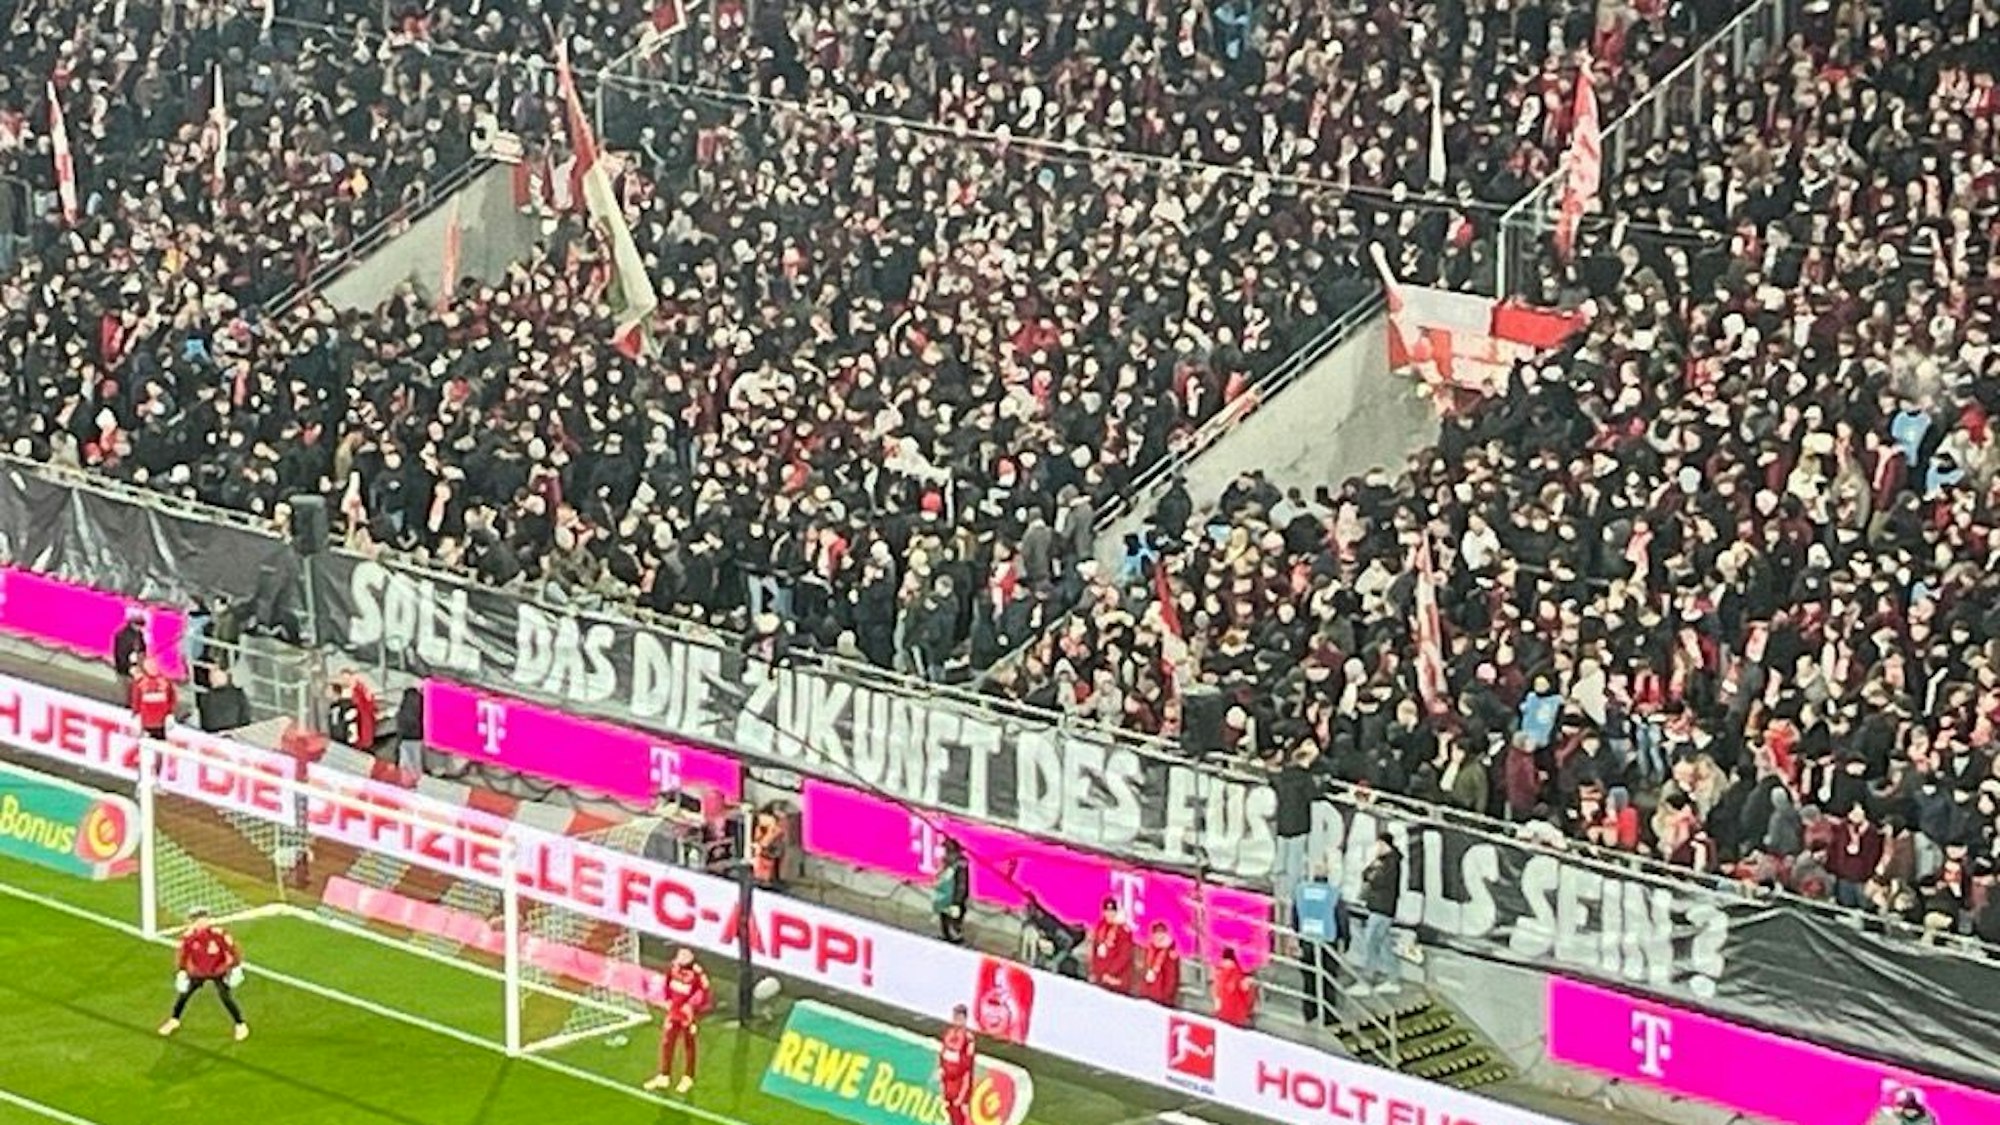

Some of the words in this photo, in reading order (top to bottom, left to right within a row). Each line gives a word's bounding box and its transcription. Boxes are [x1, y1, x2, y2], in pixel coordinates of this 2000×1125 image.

[349, 561, 481, 671] SOLL
[512, 603, 617, 701] DAS
[631, 631, 726, 738] DIE
[735, 657, 1002, 816] ZUKUNFT
[1016, 730, 1145, 843] DES
[0, 794, 76, 854] Bonus
[618, 867, 874, 987] FC-APP!
[772, 1029, 871, 1099] REWE
[1256, 1060, 1377, 1124] HOLT
